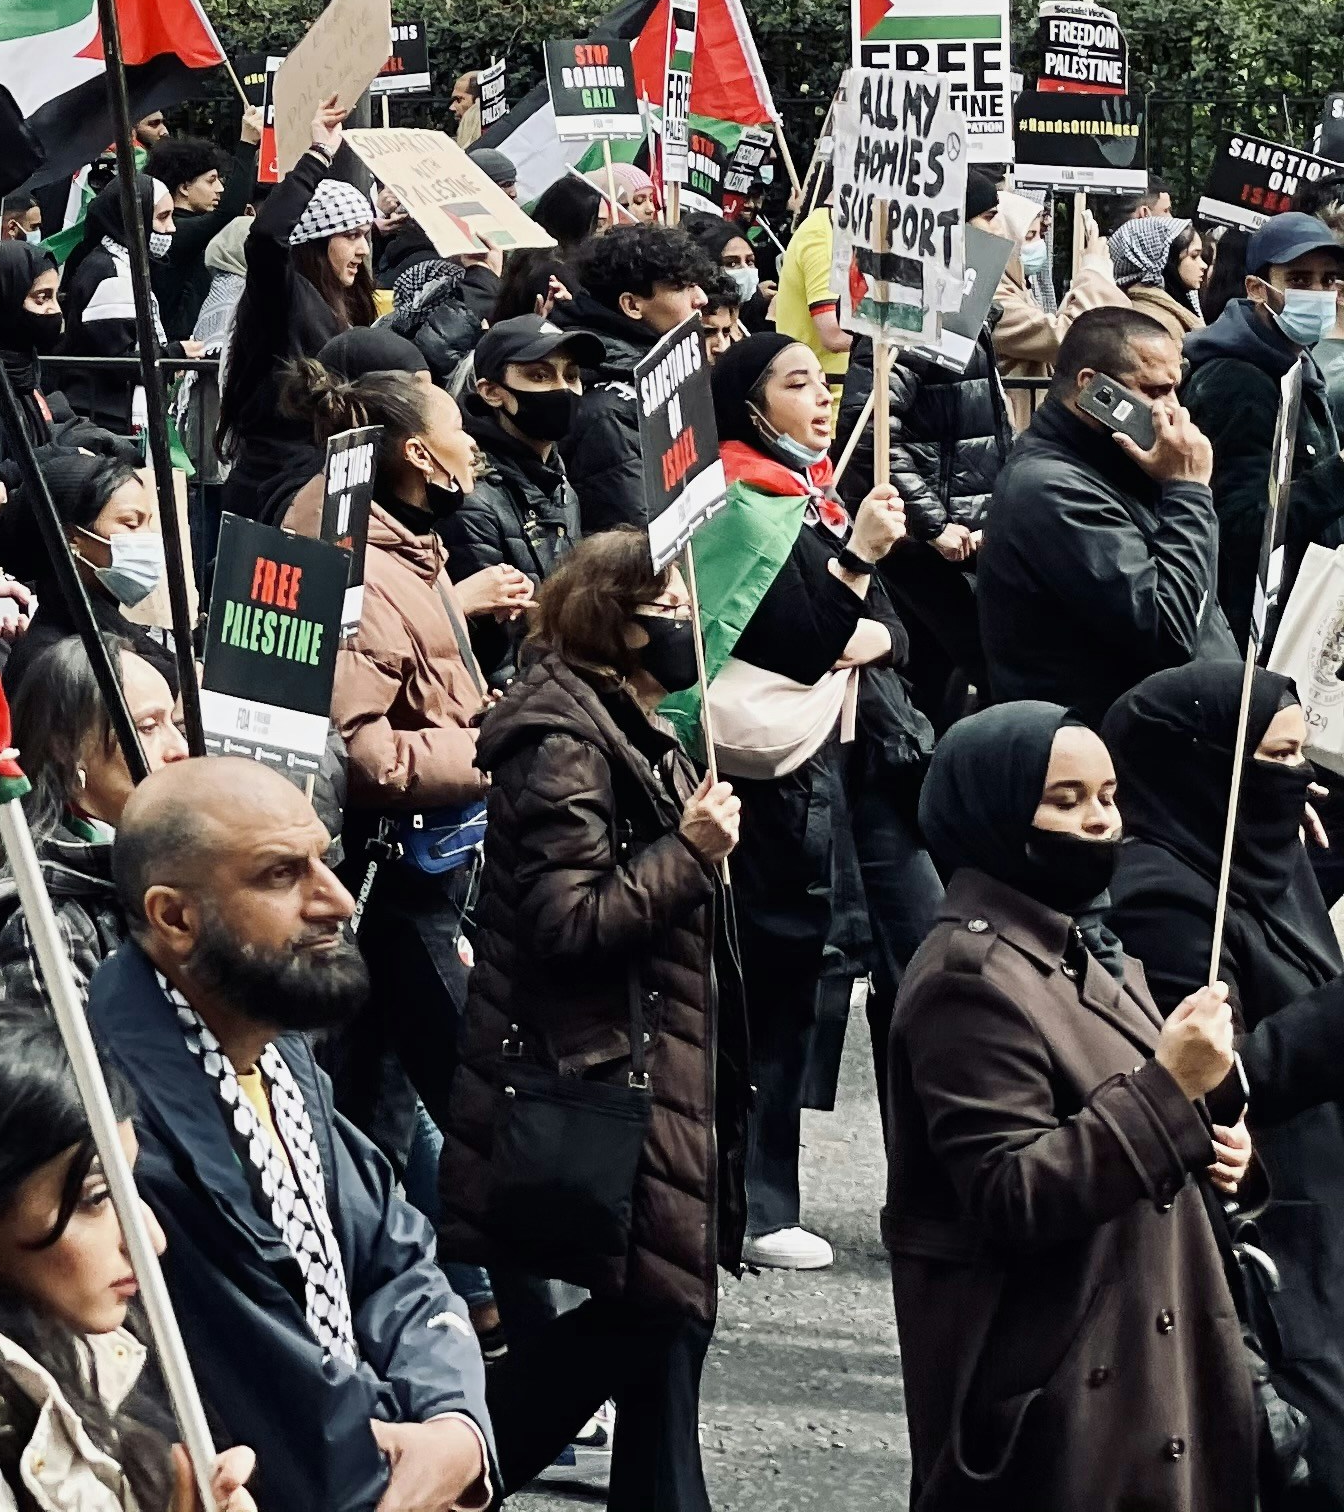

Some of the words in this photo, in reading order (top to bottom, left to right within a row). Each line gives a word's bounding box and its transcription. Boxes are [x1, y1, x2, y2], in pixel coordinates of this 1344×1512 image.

[1049, 20, 1119, 50] FREEDOM
[574, 45, 609, 65] STOP
[861, 43, 1003, 92] FREE
[1045, 52, 1123, 85] PALESTINE
[562, 66, 625, 87] BOMBING
[582, 88, 616, 108] GAZA
[860, 73, 900, 132] ALL
[902, 79, 941, 139] MY
[352, 132, 445, 159] SOLIDARITY
[1228, 137, 1336, 182] SANCTION
[854, 134, 946, 198] HOMIES
[391, 174, 482, 207] PALESTINE
[1241, 184, 1291, 213] ISRA
[1268, 171, 1299, 196] ON
[251, 556, 302, 611] FREE
[221, 599, 324, 666] PALESTINE
